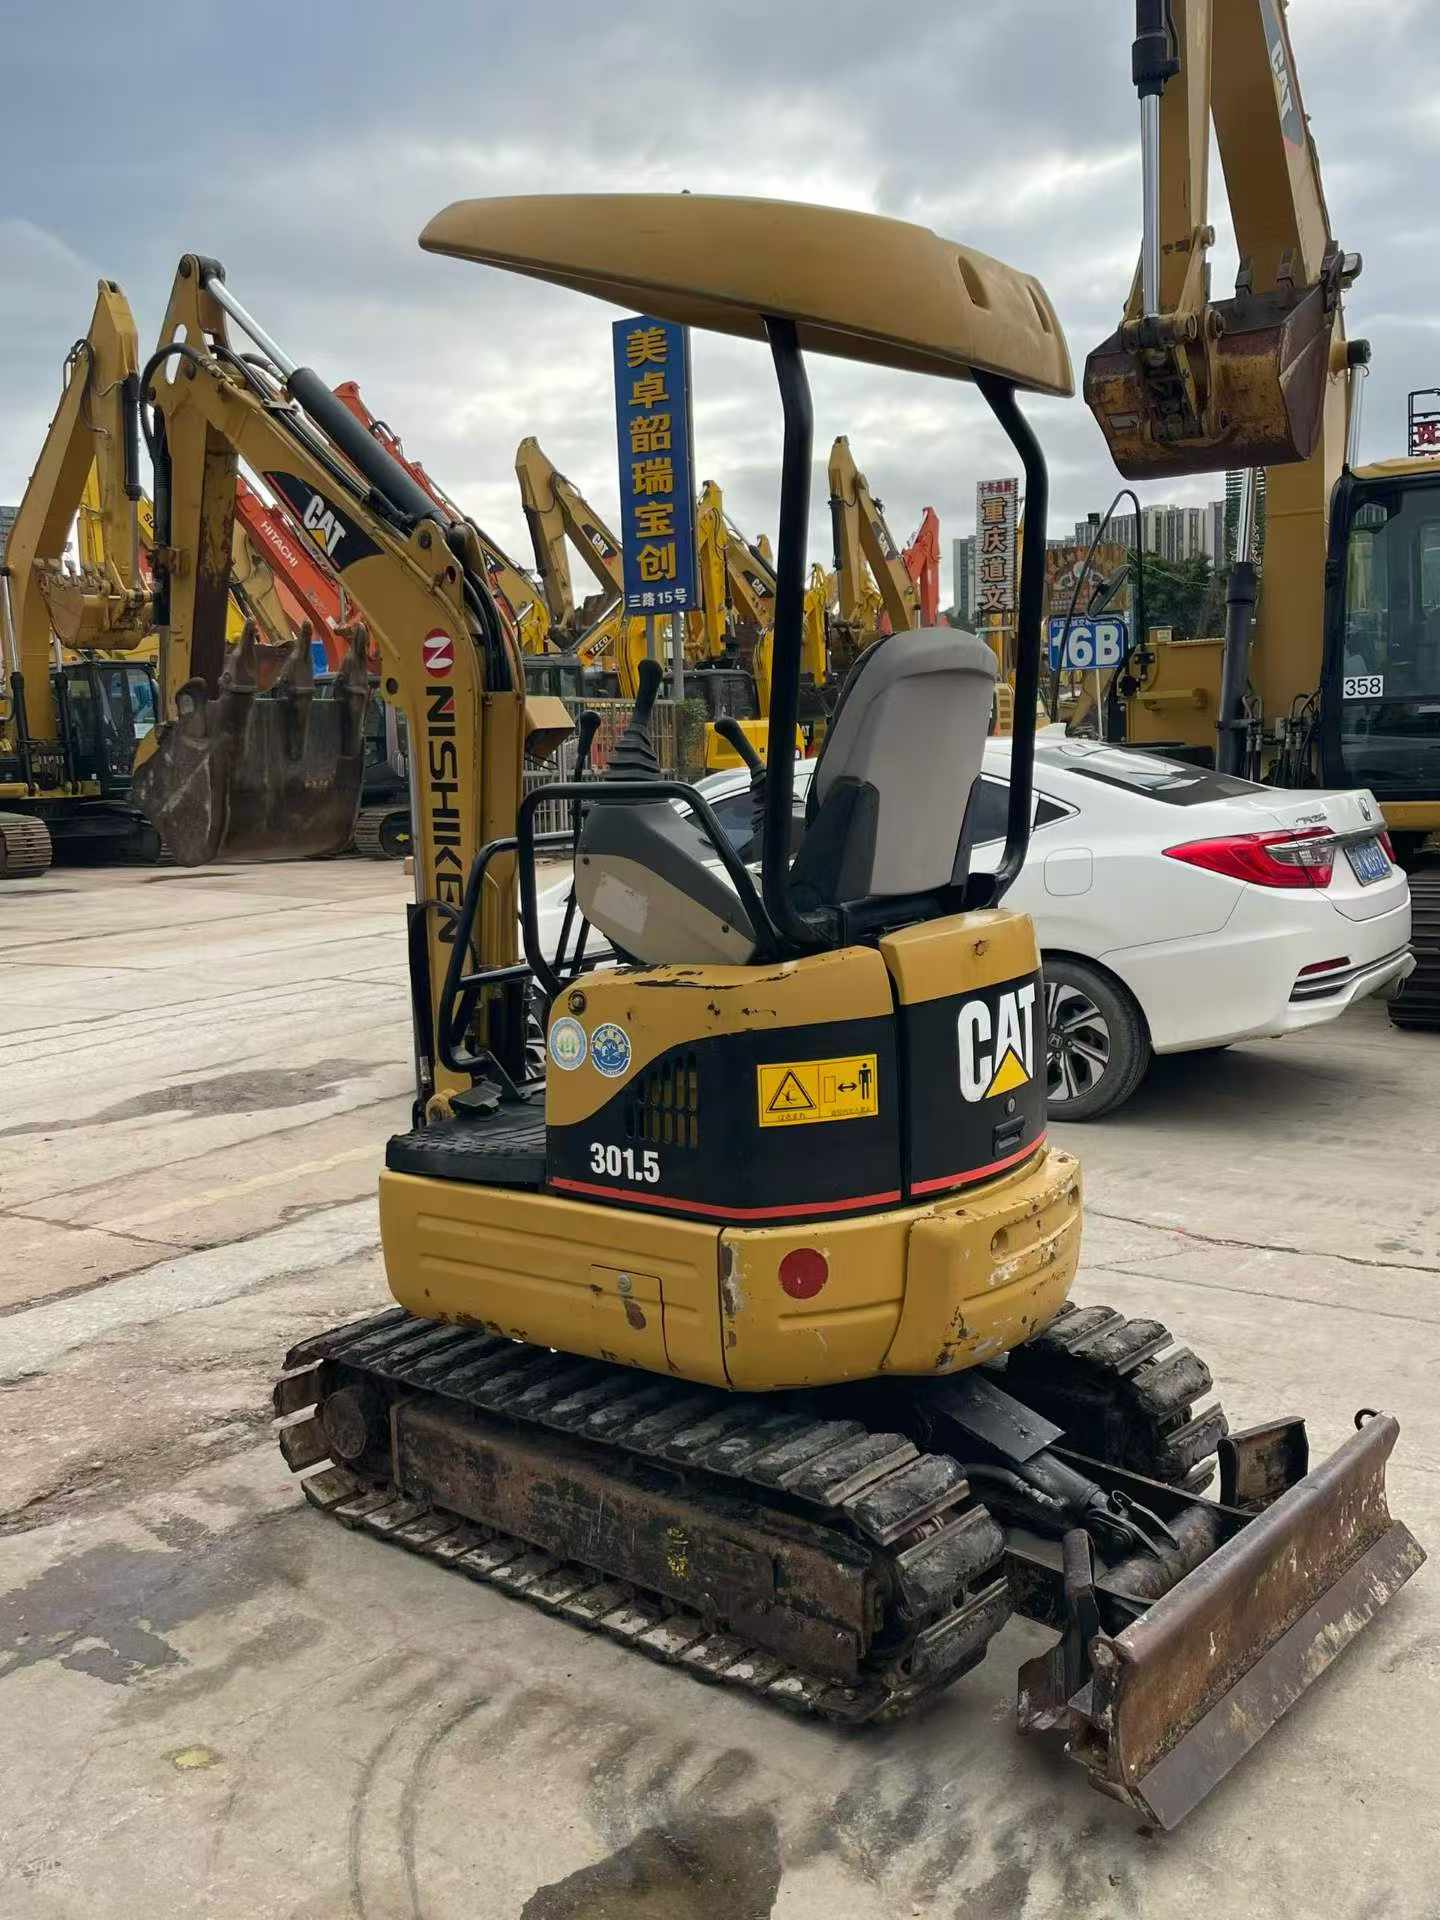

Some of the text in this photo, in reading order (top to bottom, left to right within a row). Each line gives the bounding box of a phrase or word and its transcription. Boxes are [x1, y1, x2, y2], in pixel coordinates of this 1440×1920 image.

[1271, 40, 1293, 121] CAT
[626, 327, 677, 582] 美卓韶瑞宝创
[260, 520, 300, 568] HITACHI
[302, 494, 347, 558] CAT
[592, 532, 609, 556] CAT
[981, 496, 1008, 612] 重庆道文
[628, 588, 688, 609] 三路15号
[751, 578, 767, 597] CAT
[1051, 625, 1121, 668] 16B
[1344, 677, 1382, 697] 358
[425, 686, 464, 944] NISHIKEN
[956, 983, 1036, 1103] CAT
[589, 1142, 662, 1184] 301.5
